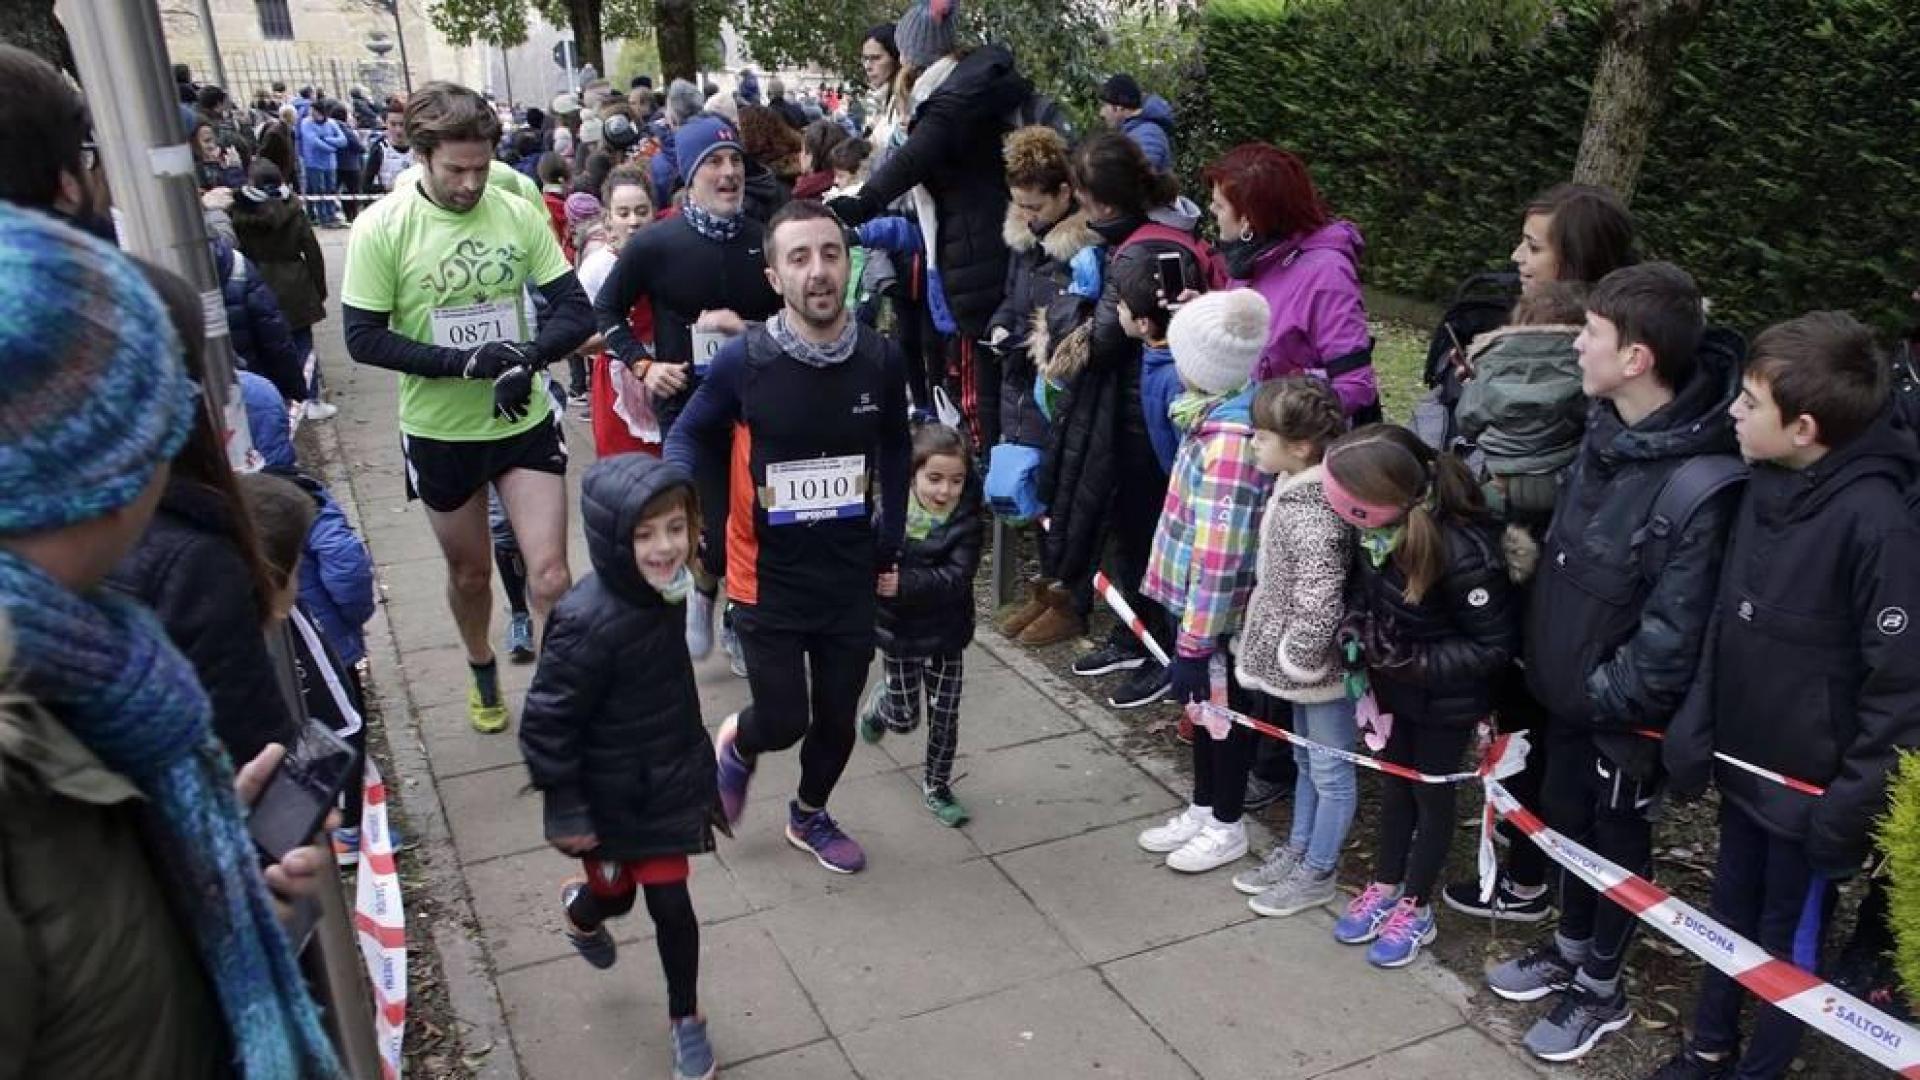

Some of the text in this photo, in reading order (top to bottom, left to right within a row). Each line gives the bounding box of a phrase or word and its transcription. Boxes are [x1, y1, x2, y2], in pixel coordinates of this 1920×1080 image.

[449, 320, 502, 345] 0871
[787, 476, 848, 500] 1010
[1685, 916, 1735, 954] DICONA
[1835, 1005, 1901, 1047] SALTOKI
